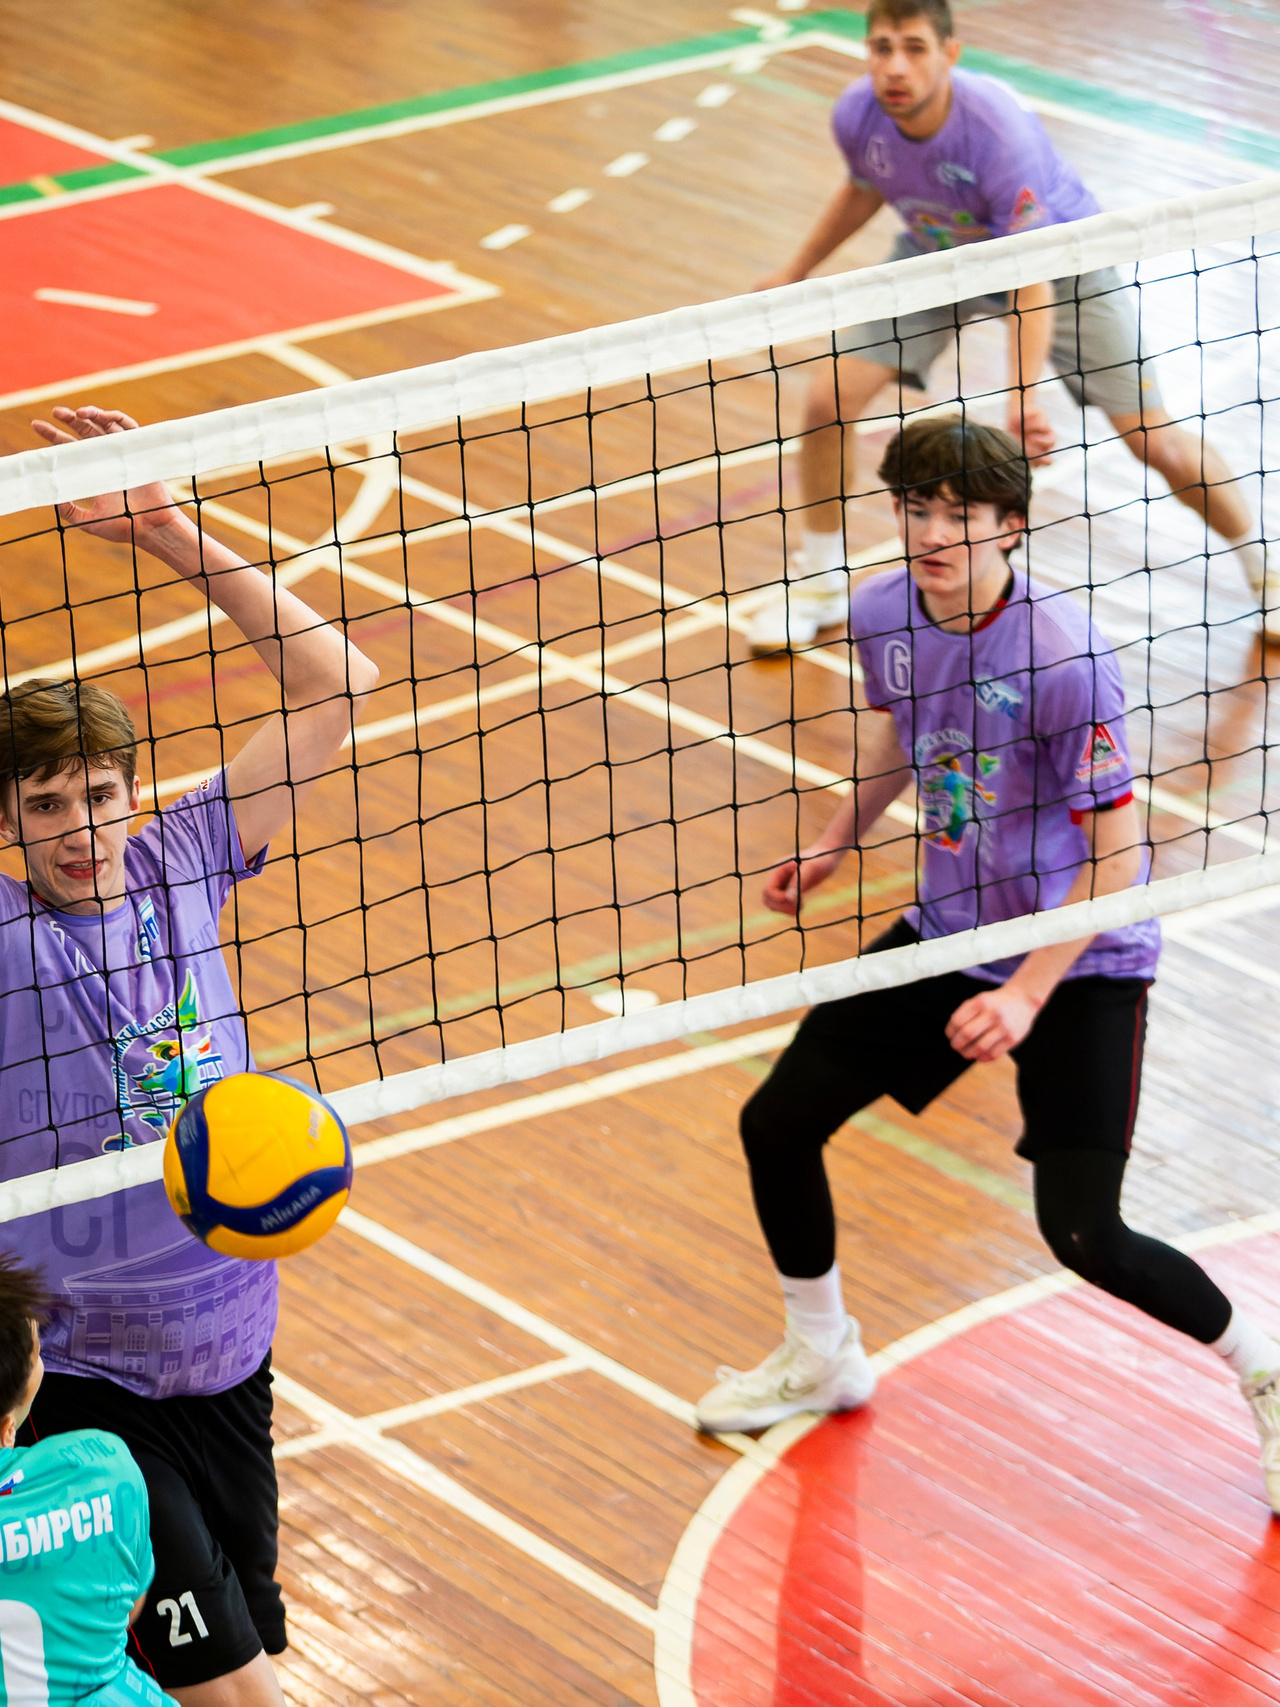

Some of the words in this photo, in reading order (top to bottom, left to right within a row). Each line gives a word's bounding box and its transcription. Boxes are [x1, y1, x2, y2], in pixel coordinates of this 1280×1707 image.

[884, 640, 912, 696] 6
[19, 1087, 109, 1129] СГУПС
[157, 1591, 209, 1647] 21
